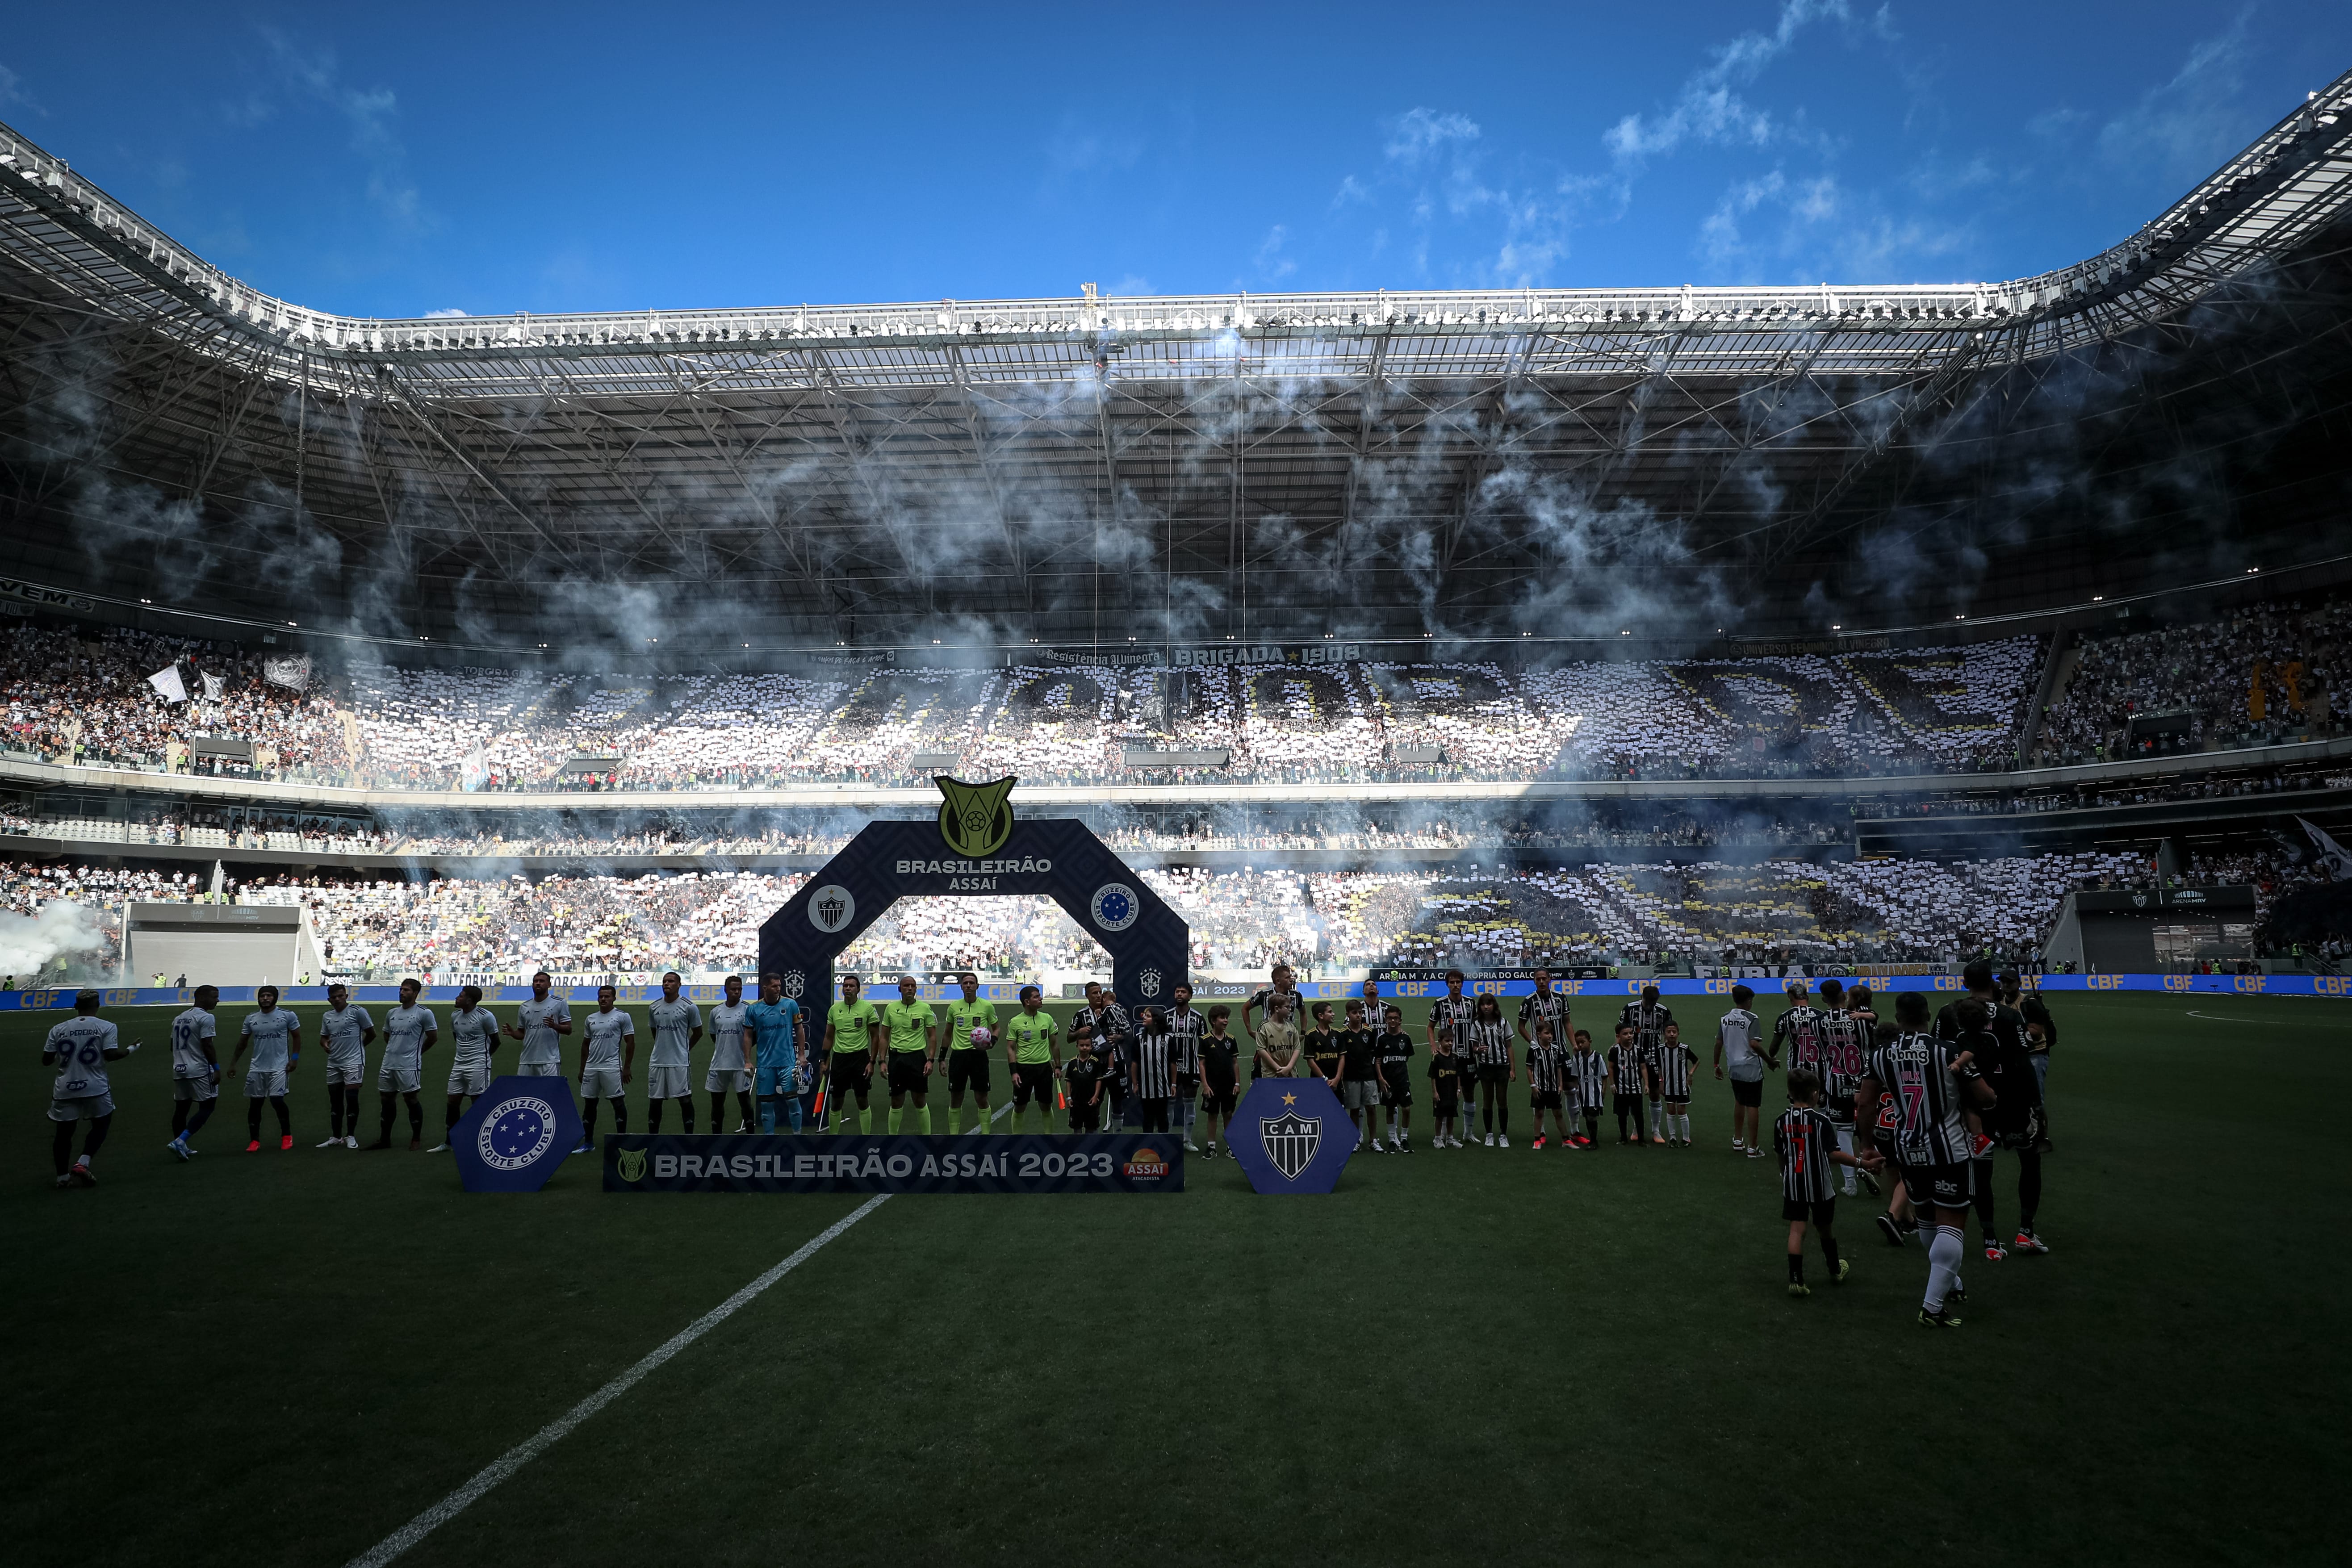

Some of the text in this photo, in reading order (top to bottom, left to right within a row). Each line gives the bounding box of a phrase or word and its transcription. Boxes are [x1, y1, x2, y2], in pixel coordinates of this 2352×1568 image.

[1743, 636, 1890, 655] UNIVERSO FEMININO ALVINEGRO
[1046, 648, 1159, 665] Resistência Alvinegra
[1175, 645, 1360, 665] BRIGADA 1908
[896, 856, 1051, 874] BRASILEIRÃO
[949, 876, 997, 890] ASSAÍ
[1098, 887, 1130, 901] CRUZEIRO
[1096, 902, 1134, 926] ESPORTE CLUBE
[1856, 963, 1929, 976] MBAIXADORES
[1409, 973, 1428, 981] MV,
[1858, 977, 1891, 991] CBF
[2020, 976, 2042, 990] BF
[2087, 975, 2124, 989] CBF
[2163, 975, 2193, 990] CBF
[2234, 975, 2267, 991] CBF
[1214, 986, 1246, 995] 2023
[1318, 983, 1352, 997] CBF
[1396, 981, 1429, 996] CBF
[1473, 981, 1507, 995] CBF
[1551, 981, 1584, 995] CBF
[1705, 979, 1738, 993] CBF
[2314, 976, 2352, 994] CBF
[20, 991, 60, 1008] CBF
[105, 989, 138, 1005] CBF
[178, 987, 196, 1003] CB
[482, 987, 503, 1000] BF
[549, 987, 574, 1000] BF
[617, 986, 647, 1000] CBF
[689, 986, 720, 999] CBF
[1728, 1019, 1745, 1029] bmg
[1829, 1020, 1854, 1030] bmg
[175, 1025, 191, 1050] 19
[59, 1037, 98, 1068] 96
[1795, 1035, 1820, 1063] 15
[1826, 1044, 1861, 1076] 26
[1898, 1049, 1929, 1065] bmg
[493, 1100, 550, 1120] CRUZEIRO
[1901, 1084, 1924, 1132] 7
[1269, 1124, 1312, 1135] CAM
[482, 1126, 552, 1167] ESPORTE CLUBE
[1790, 1137, 1806, 1173] 7
[1909, 1151, 1927, 1162] BH
[655, 1147, 1113, 1178] BRASILEIRÃO ASSAÍ 2023
[1127, 1163, 1163, 1175] ASSAÍ
[1935, 1180, 1958, 1192] abc
